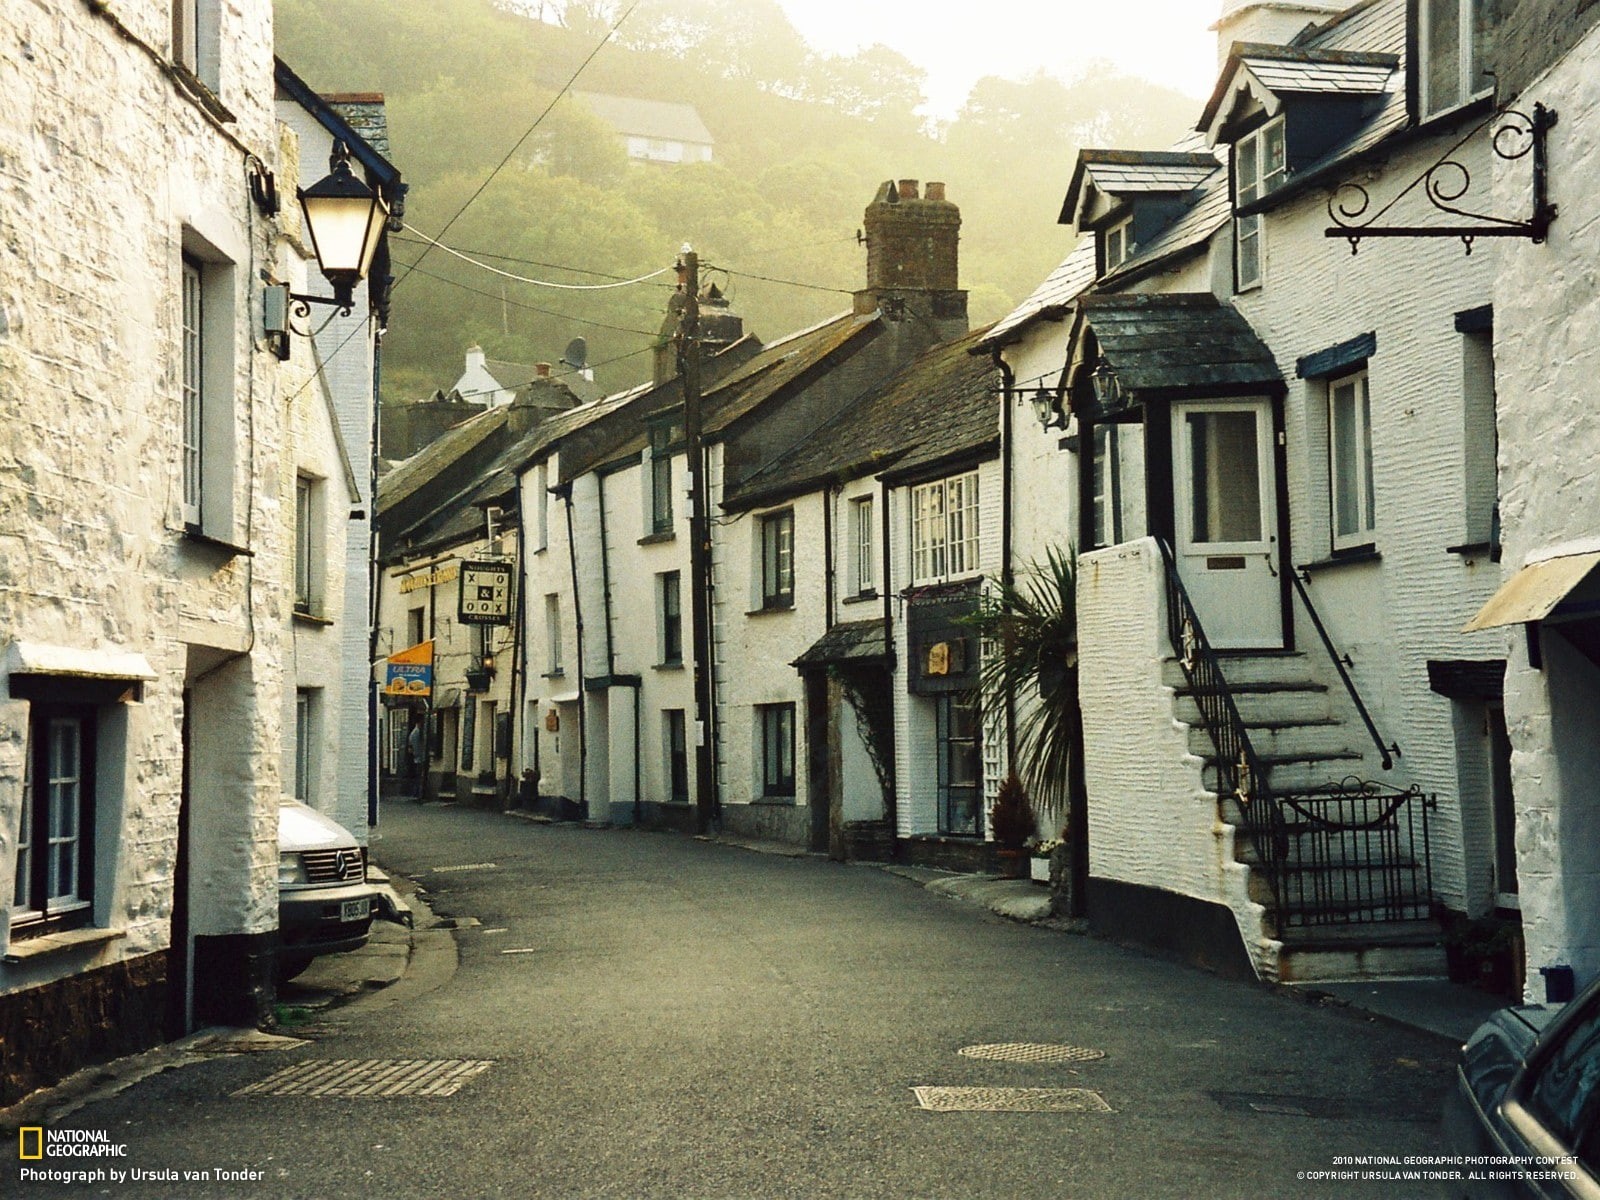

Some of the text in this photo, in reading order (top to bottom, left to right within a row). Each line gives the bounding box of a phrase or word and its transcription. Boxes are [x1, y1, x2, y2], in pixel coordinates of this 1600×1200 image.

[468, 573, 475, 583] X
[480, 588, 503, 598] & X
[495, 604, 502, 613] X
[392, 666, 426, 674] ULTRA
